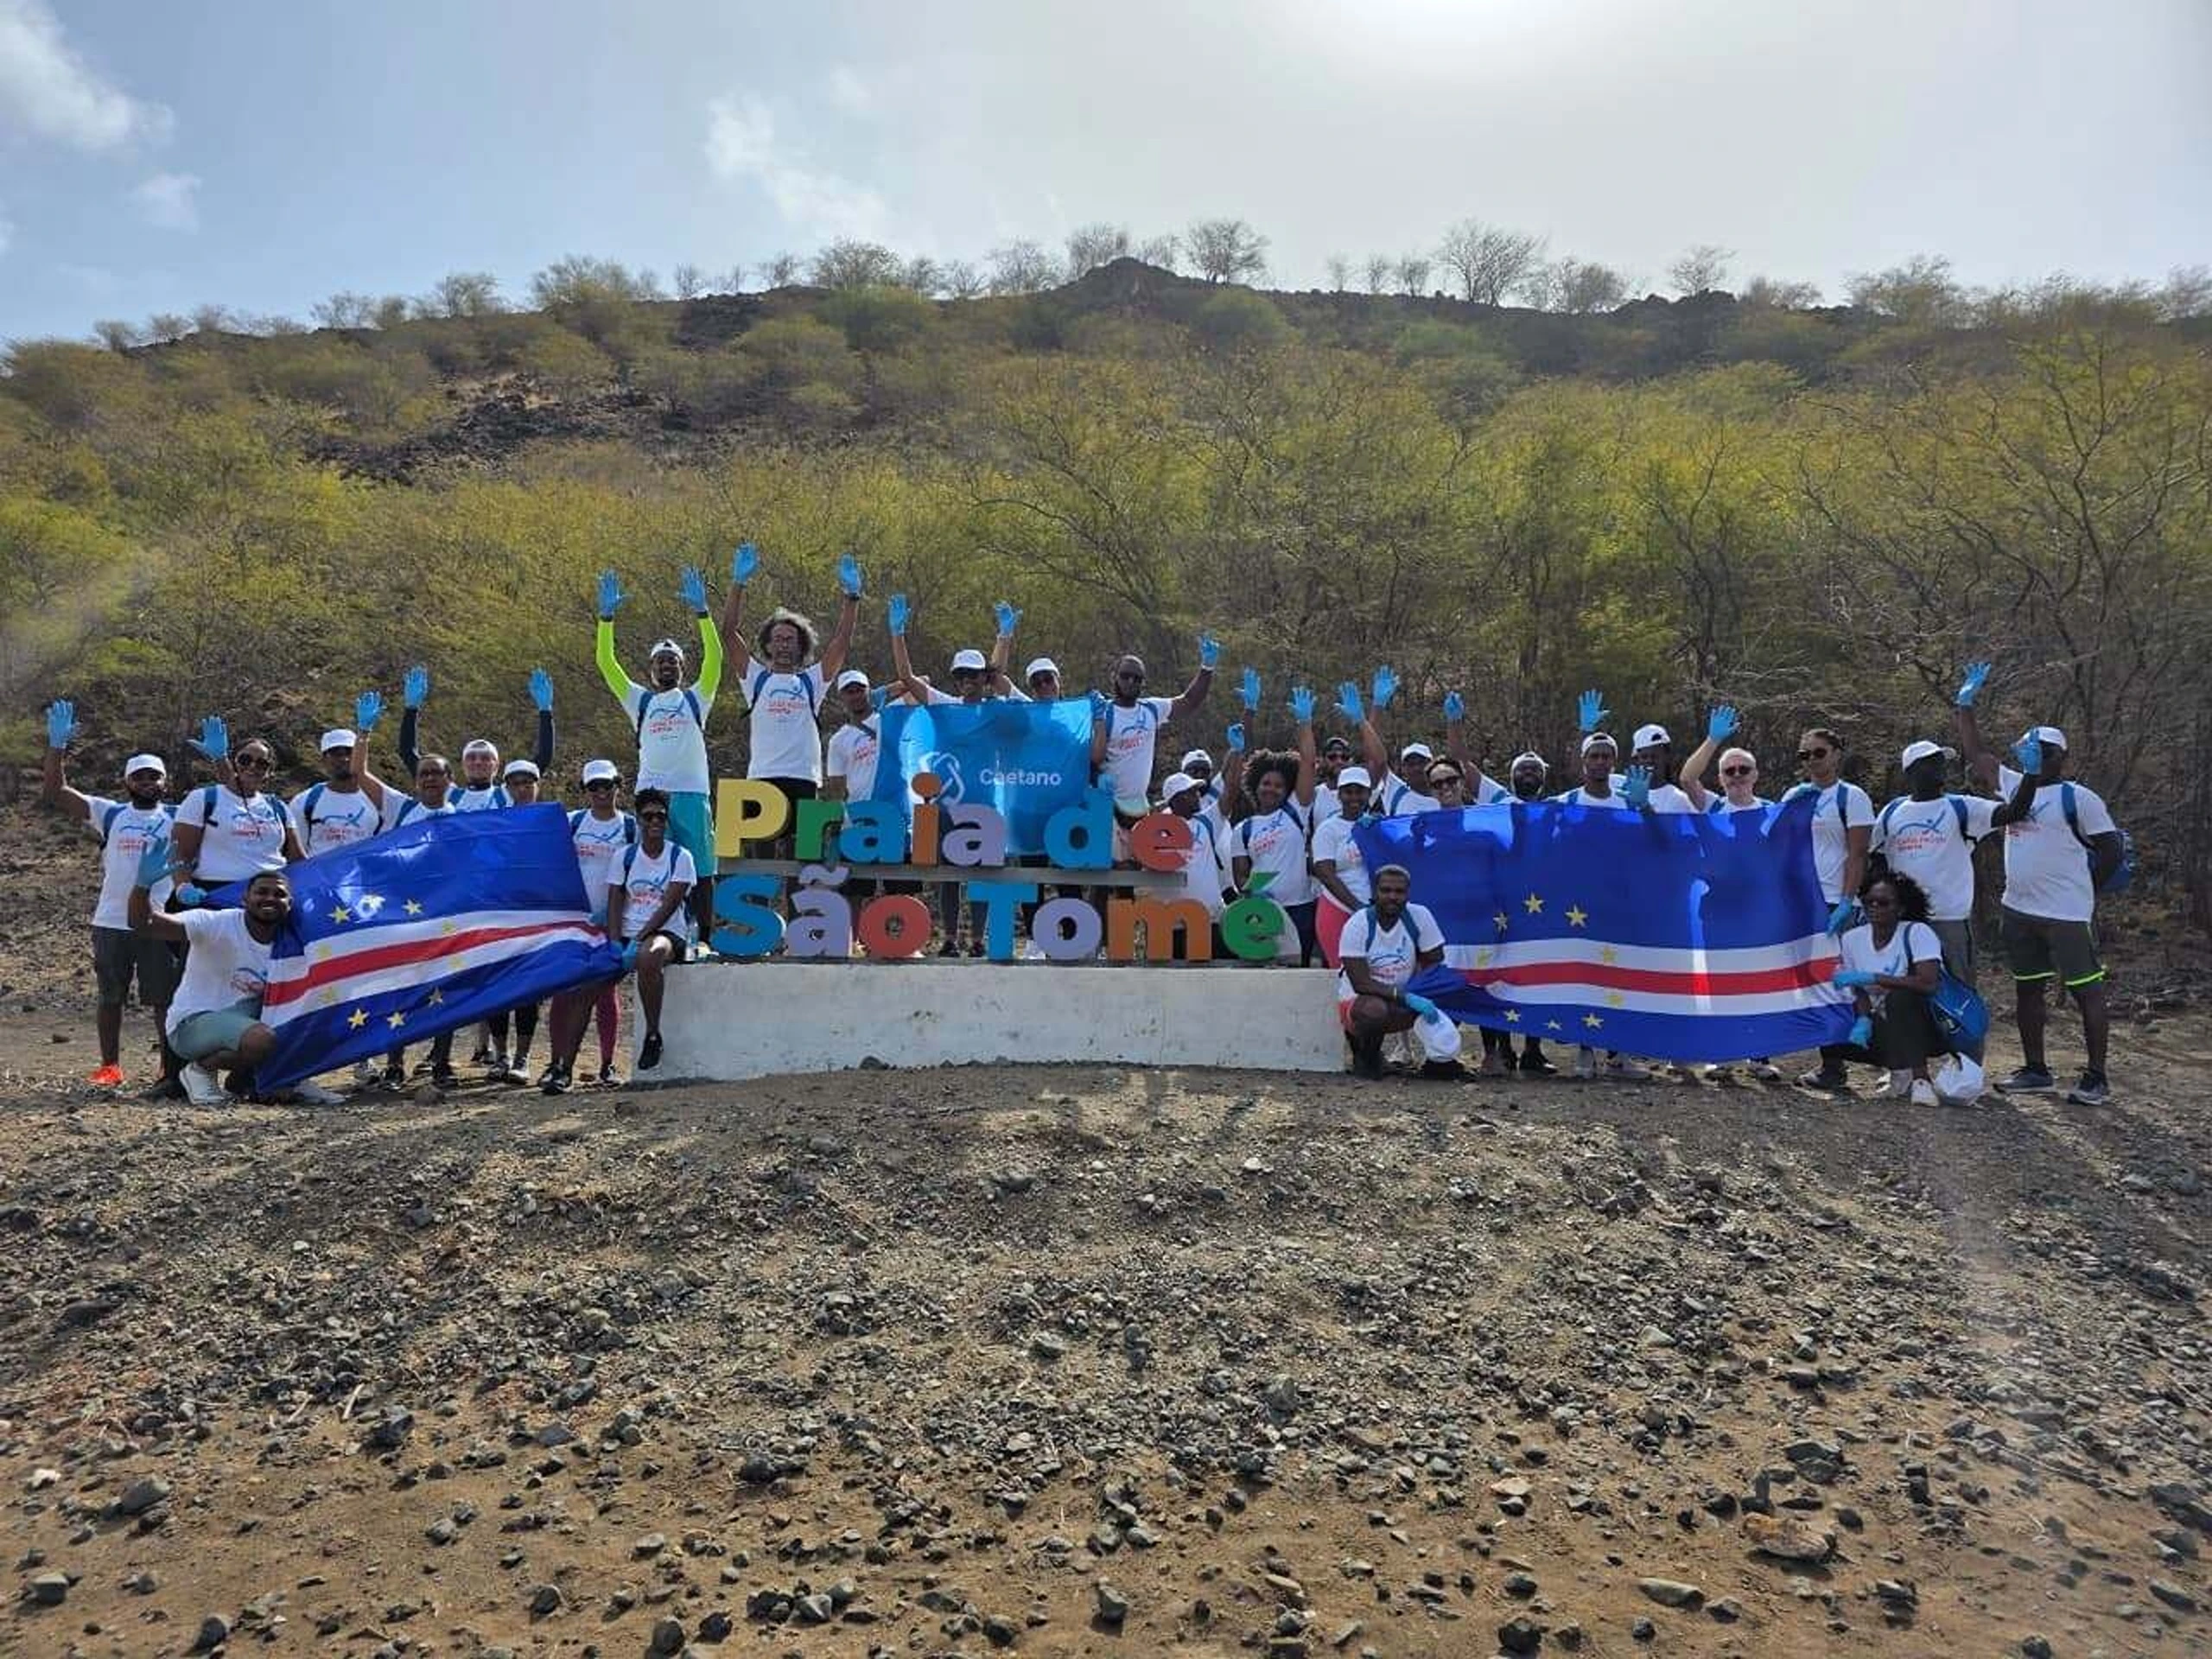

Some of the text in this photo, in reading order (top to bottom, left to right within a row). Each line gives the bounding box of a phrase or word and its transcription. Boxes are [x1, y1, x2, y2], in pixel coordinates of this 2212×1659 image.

[715, 772, 1194, 872] Praia de
[979, 767, 1063, 786] Caetano
[709, 864, 1284, 963] São Tomé
